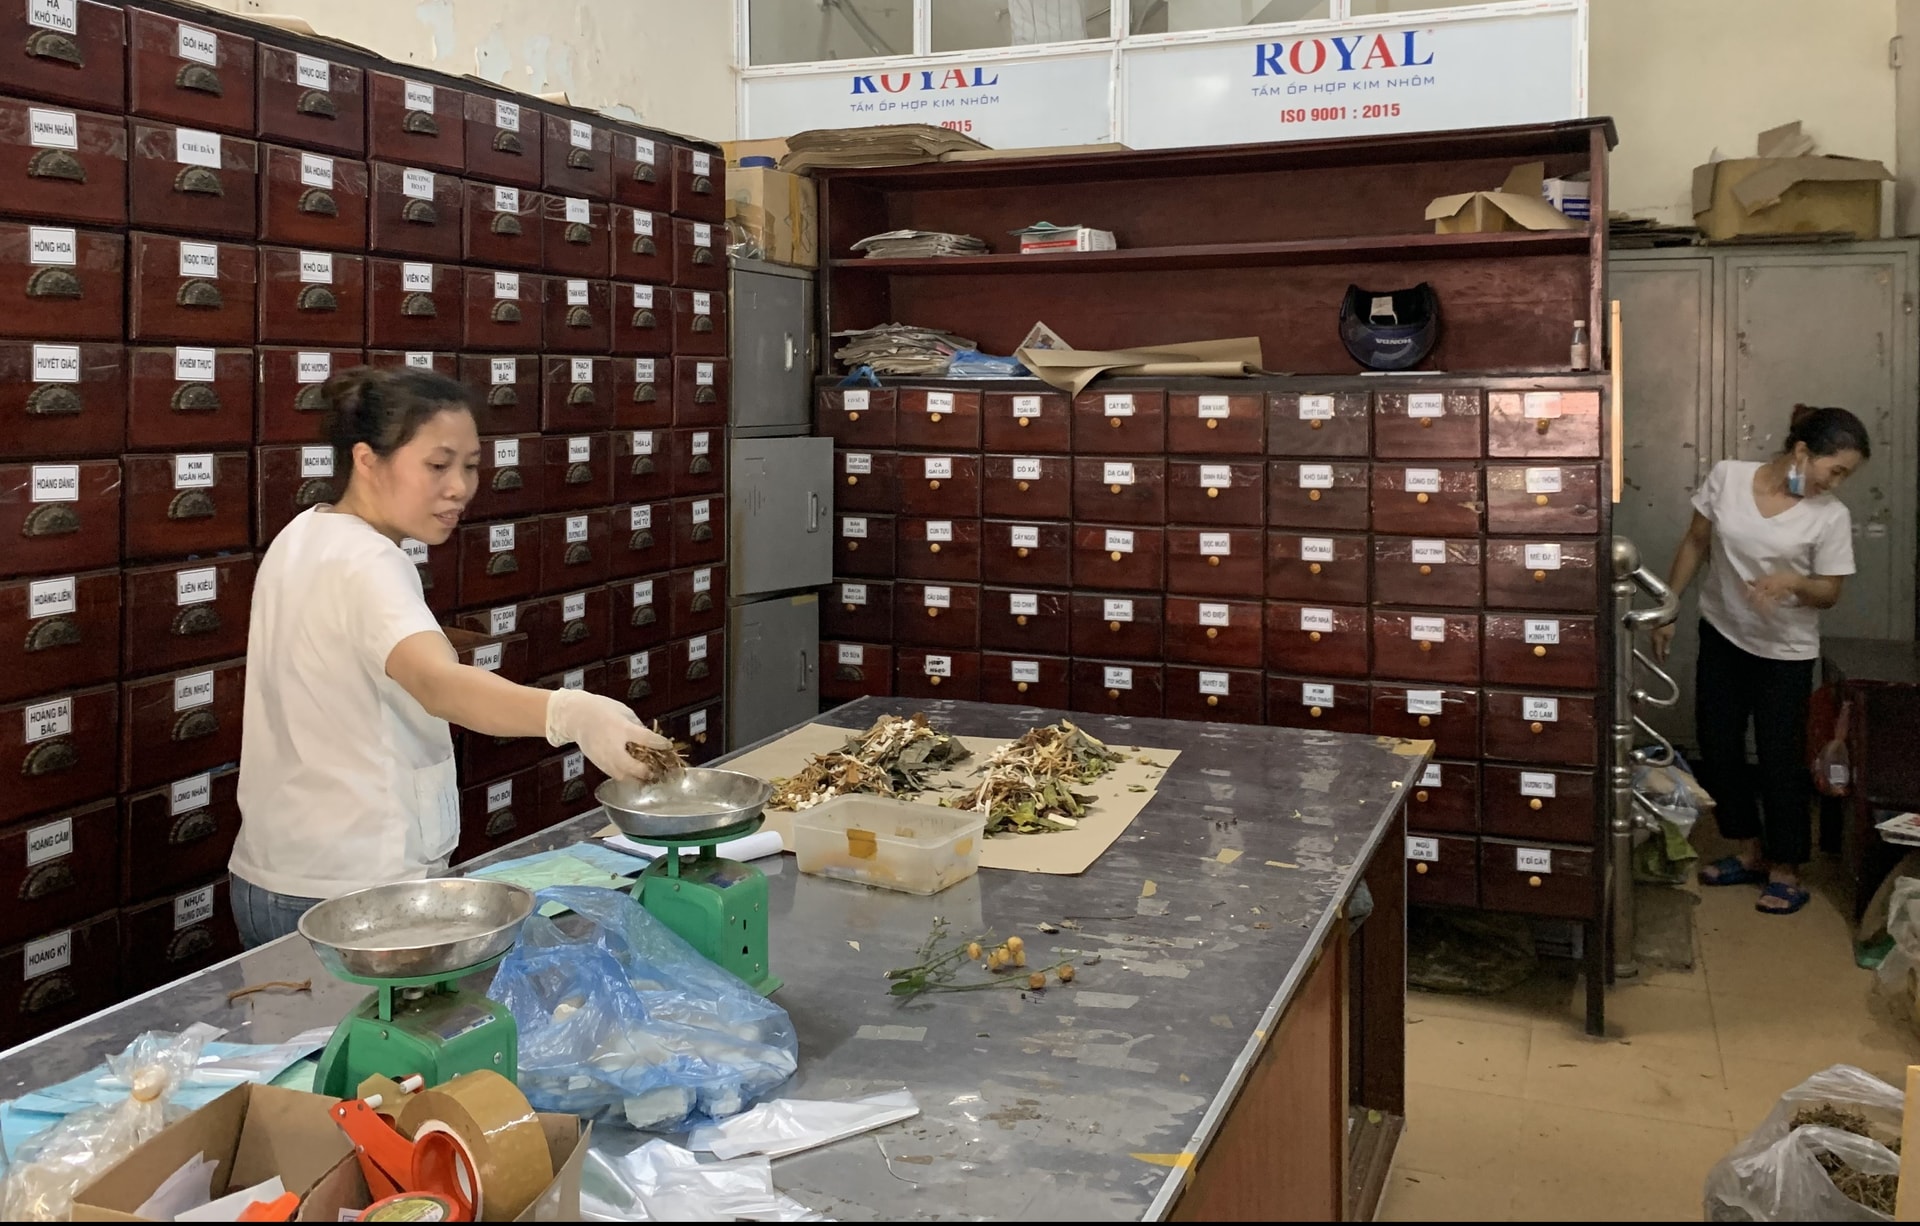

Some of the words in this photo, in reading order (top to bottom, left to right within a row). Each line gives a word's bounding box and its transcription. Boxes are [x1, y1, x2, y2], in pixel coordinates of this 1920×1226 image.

[52, 14, 72, 28] THẢO
[198, 41, 213, 54] HẠC
[1252, 31, 1434, 77] ROYAL
[1252, 83, 1280, 96] TẤM
[1287, 82, 1308, 95] ỐP
[1313, 82, 1346, 95] HỢP
[1353, 80, 1380, 90] KIM
[1387, 74, 1434, 88] NHÔM
[851, 101, 874, 112] TẤM
[879, 98, 896, 112] ỐP
[901, 100, 928, 112] HỢP
[933, 100, 955, 108] KIM
[960, 94, 999, 106] NHÔM
[1280, 109, 1306, 123] ISO
[1310, 106, 1346, 121] 9001
[1362, 103, 1400, 119] 2015
[57, 242, 72, 252] HOA
[184, 254, 199, 266] NGỌC
[38, 356, 59, 369] HUYẾT
[30, 706, 56, 723] HOÀNG
[175, 791, 190, 803] LONG
[184, 893, 205, 908] NHỤC
[29, 948, 56, 966] HOÀNG
